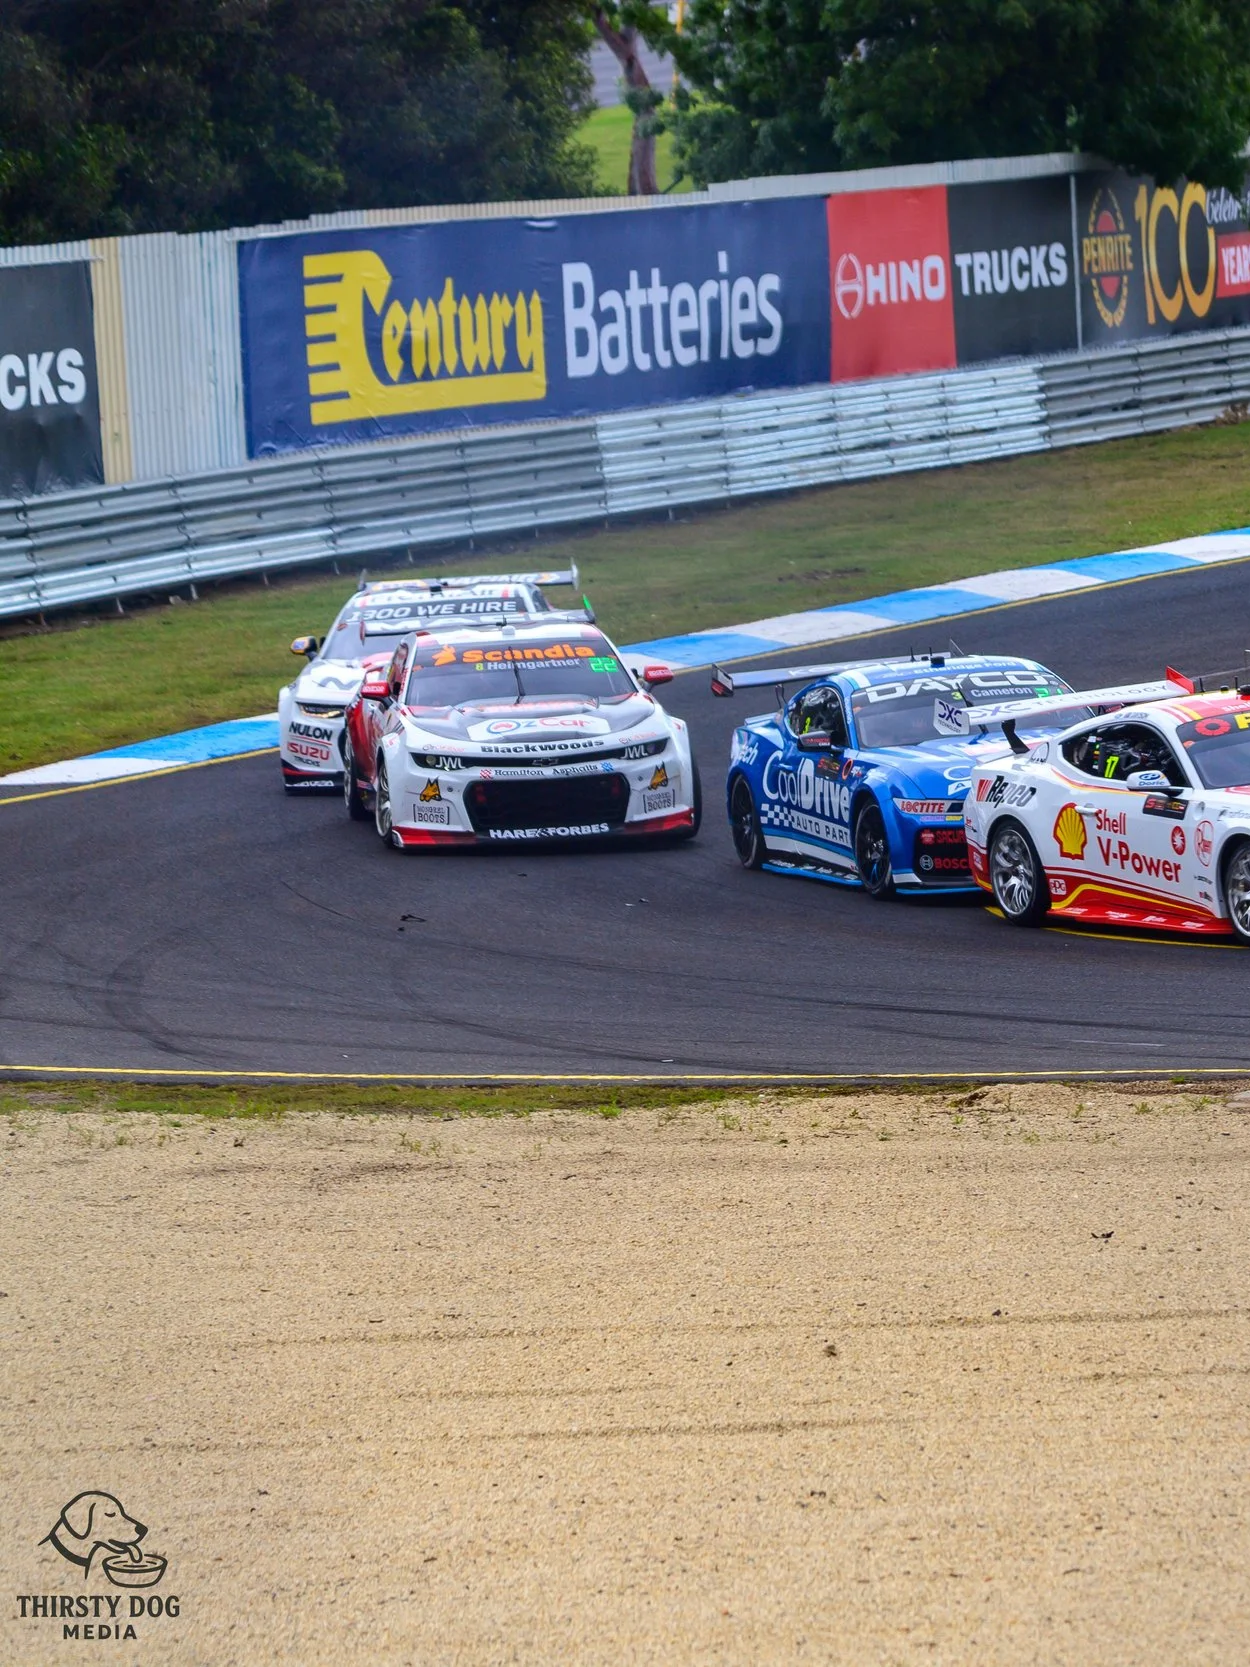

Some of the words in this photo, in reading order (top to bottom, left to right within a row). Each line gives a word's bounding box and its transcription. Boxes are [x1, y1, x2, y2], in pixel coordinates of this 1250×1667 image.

[1082, 234, 1134, 275] PENRITE
[1135, 182, 1215, 325] 100
[865, 255, 946, 303] HINO
[955, 242, 1067, 296] TRUCKS
[303, 249, 546, 425] Century
[563, 252, 782, 379] Batteries
[349, 607, 412, 621] 1300
[417, 604, 455, 617] WE
[460, 601, 516, 613] HIRE
[462, 644, 596, 663] Scandia
[487, 658, 581, 670] Heimgartner
[588, 656, 619, 673] 22
[866, 671, 1046, 699] DAYCO
[971, 687, 1032, 697] Cameron
[289, 722, 333, 742] NULON
[287, 742, 329, 761] ISUZU
[480, 739, 604, 754] Blackwoods
[620, 745, 648, 760] JWL
[435, 756, 466, 769] JWL
[494, 768, 544, 777] Hamilton
[551, 764, 598, 776] Asphalts
[1104, 755, 1120, 778] 17
[986, 775, 1036, 808] Repco
[647, 799, 672, 811] BOOTS
[901, 801, 945, 813] LOCTITE
[417, 813, 445, 824] BOOTS
[797, 818, 820, 835] AUTO
[1095, 809, 1127, 835] Shell
[1097, 836, 1182, 883] V-Power
